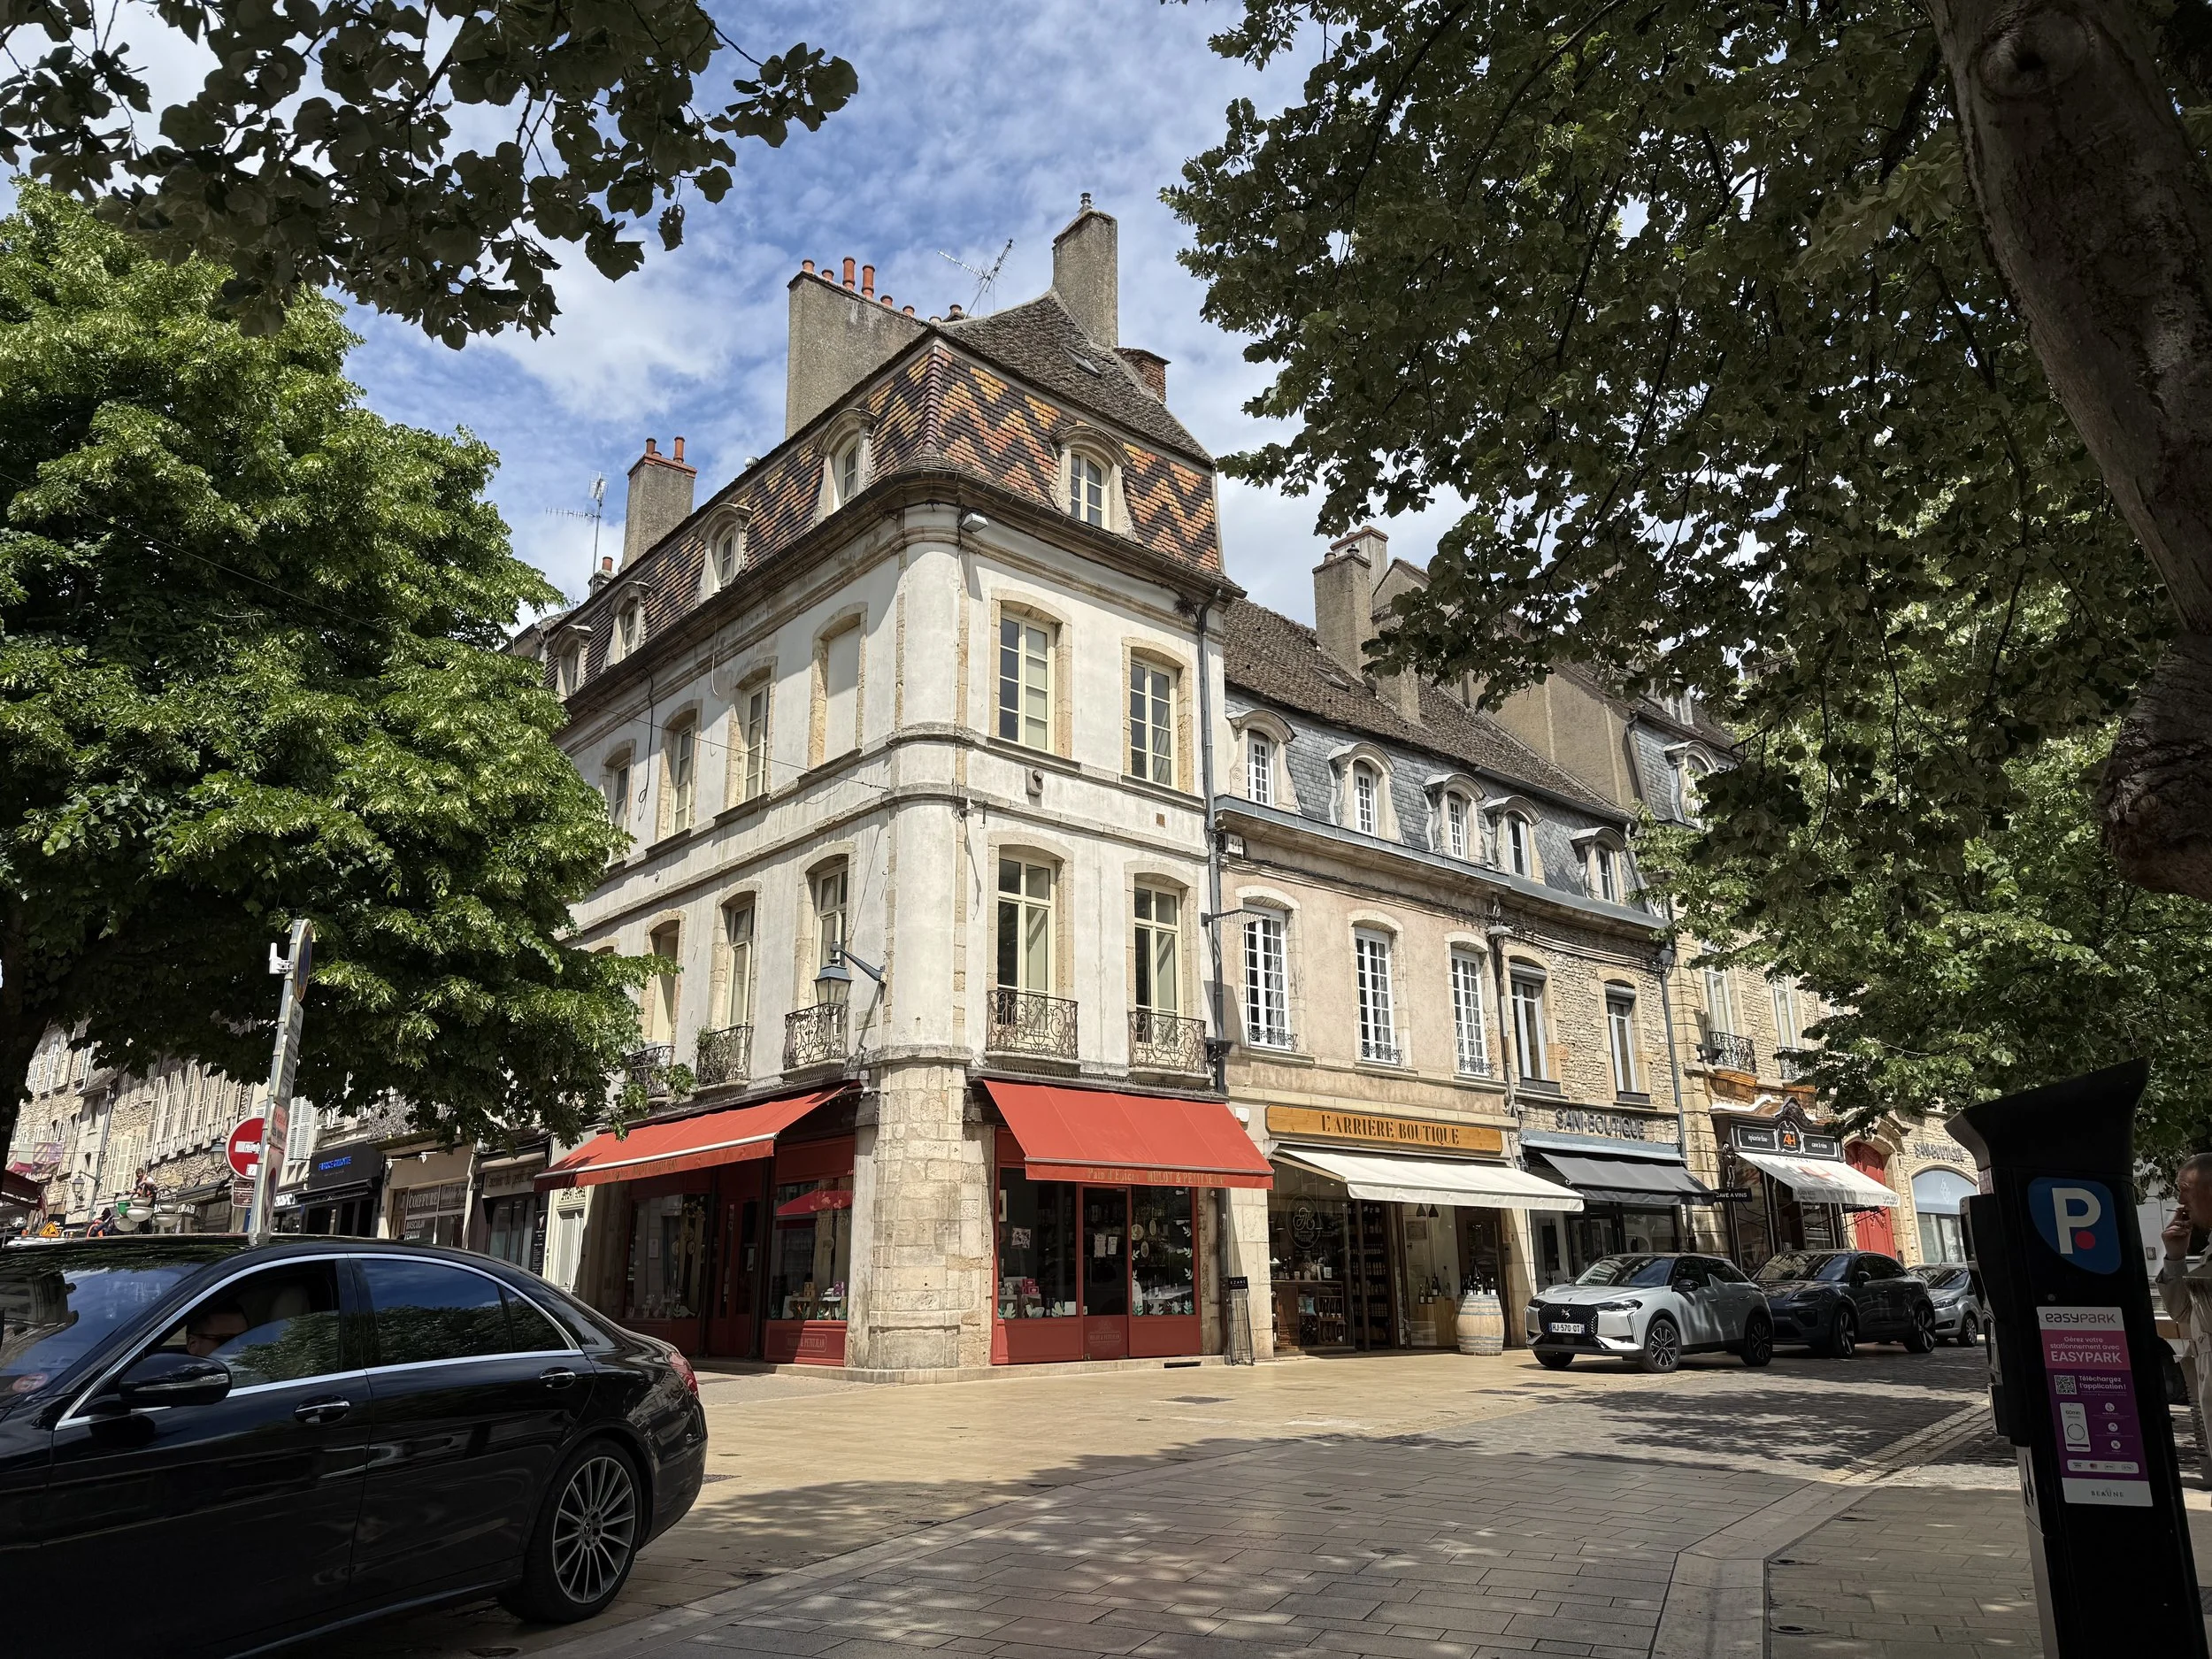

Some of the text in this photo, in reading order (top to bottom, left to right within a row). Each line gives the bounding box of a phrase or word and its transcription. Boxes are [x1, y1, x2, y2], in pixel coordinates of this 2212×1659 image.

[1321, 1114, 1460, 1147] L'ARRIÈRE BOUTIQUE
[1555, 1108, 1645, 1141] SANI-BOUTIQUE
[1175, 1171, 1182, 1184] &
[409, 1192, 439, 1209] COIFFURE
[2051, 1187, 2101, 1255] P
[2051, 1351, 2123, 1363] EASYPARK
[2078, 1375, 2122, 1384] Téléchargez
